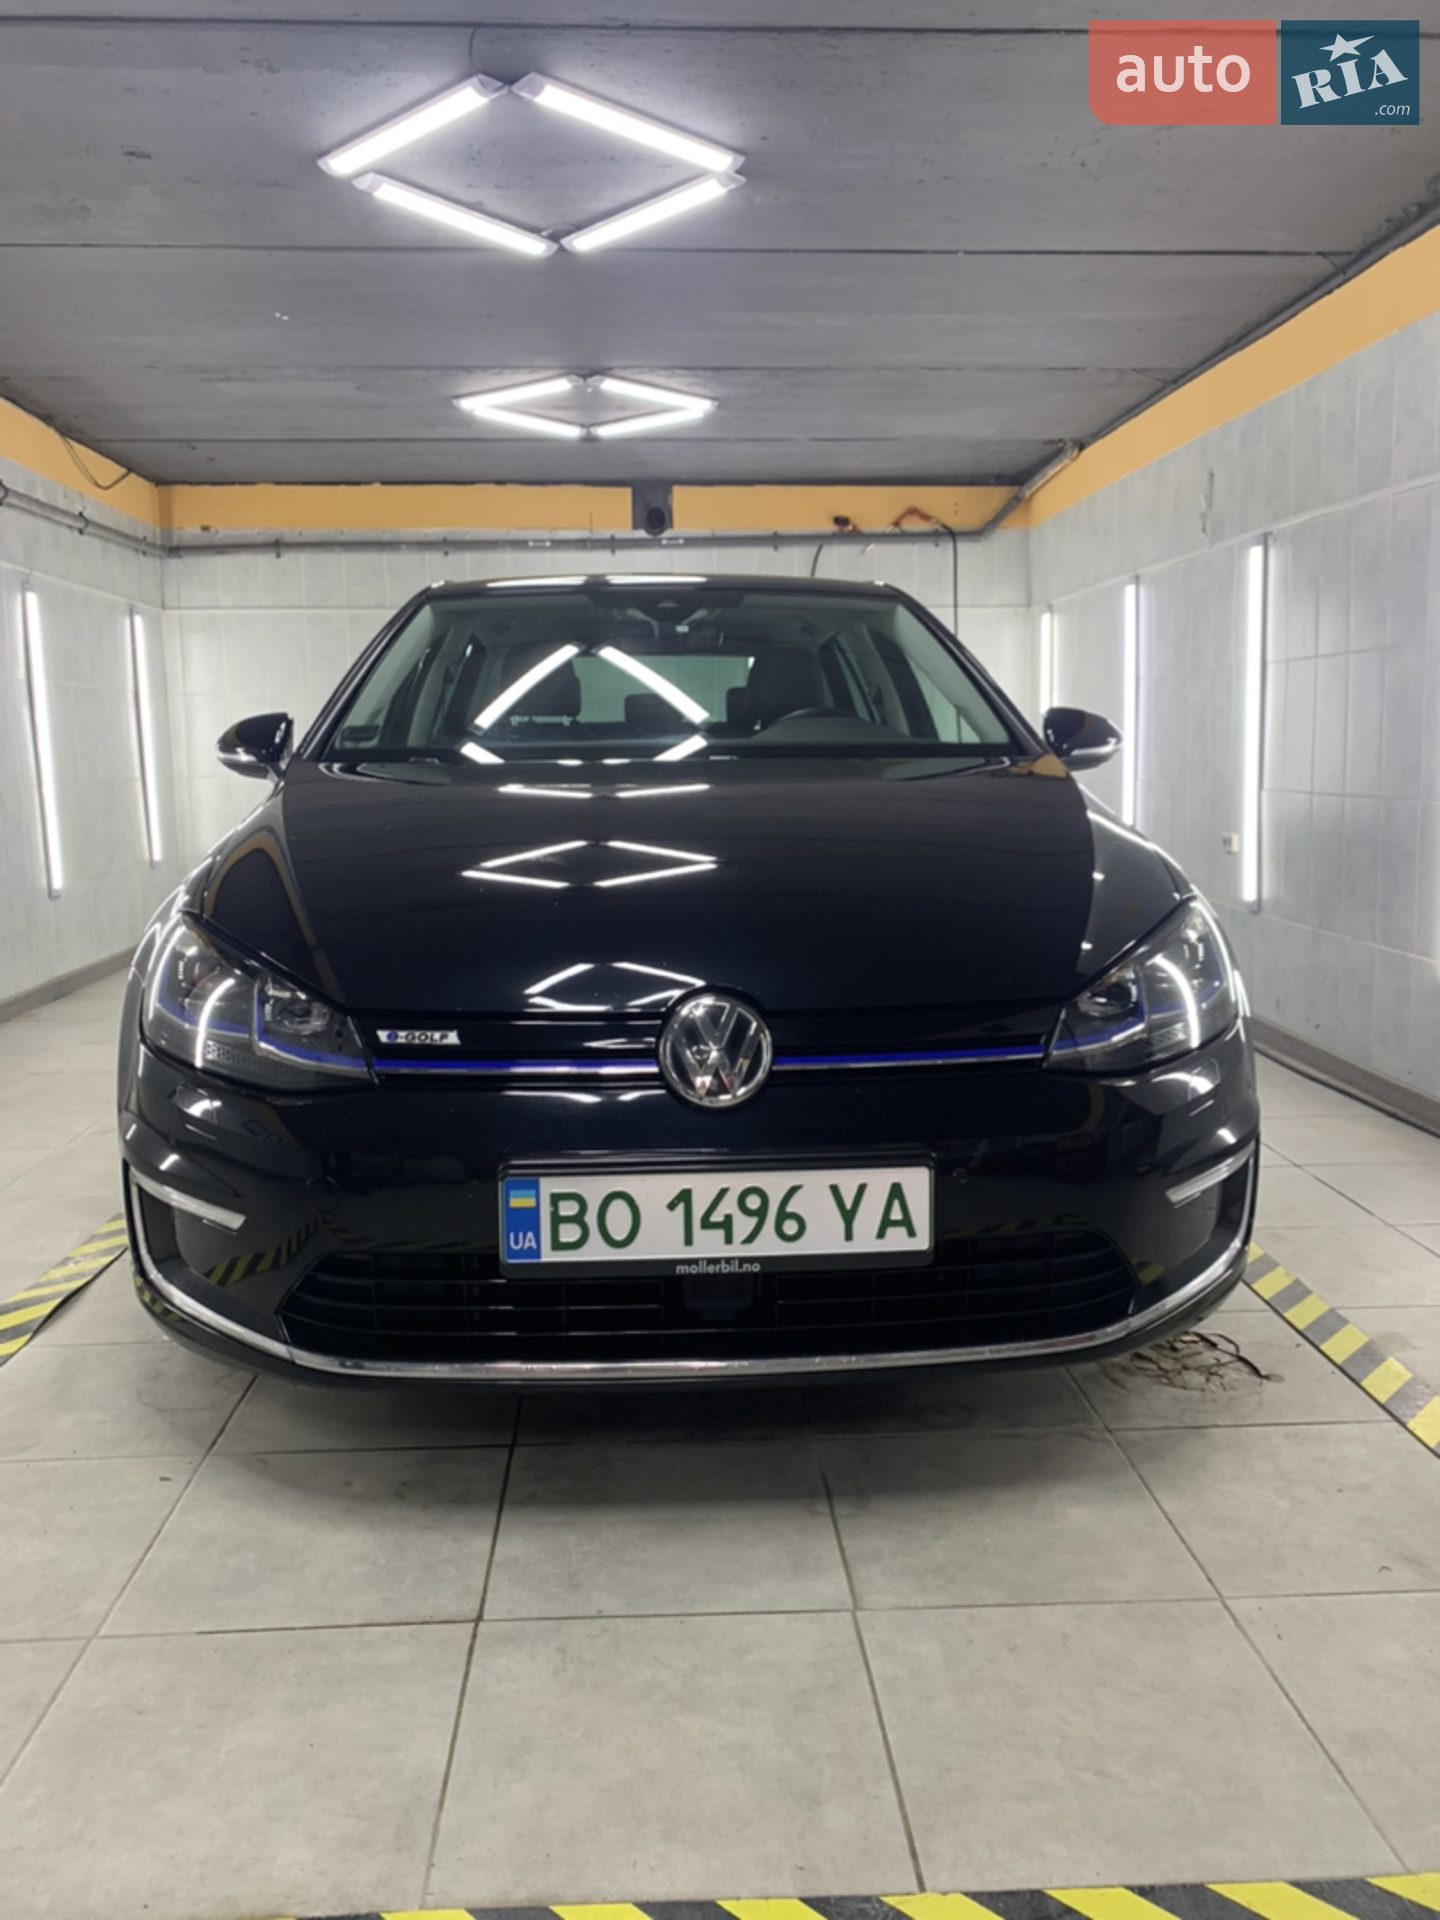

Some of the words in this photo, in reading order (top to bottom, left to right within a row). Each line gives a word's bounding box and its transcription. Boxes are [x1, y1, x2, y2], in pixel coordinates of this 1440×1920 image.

[549, 1190, 642, 1252] BO
[666, 1185, 807, 1247] 1496
[828, 1182, 917, 1242] YA
[509, 1232, 537, 1250] UA
[675, 1259, 761, 1275] mollerbil.no
